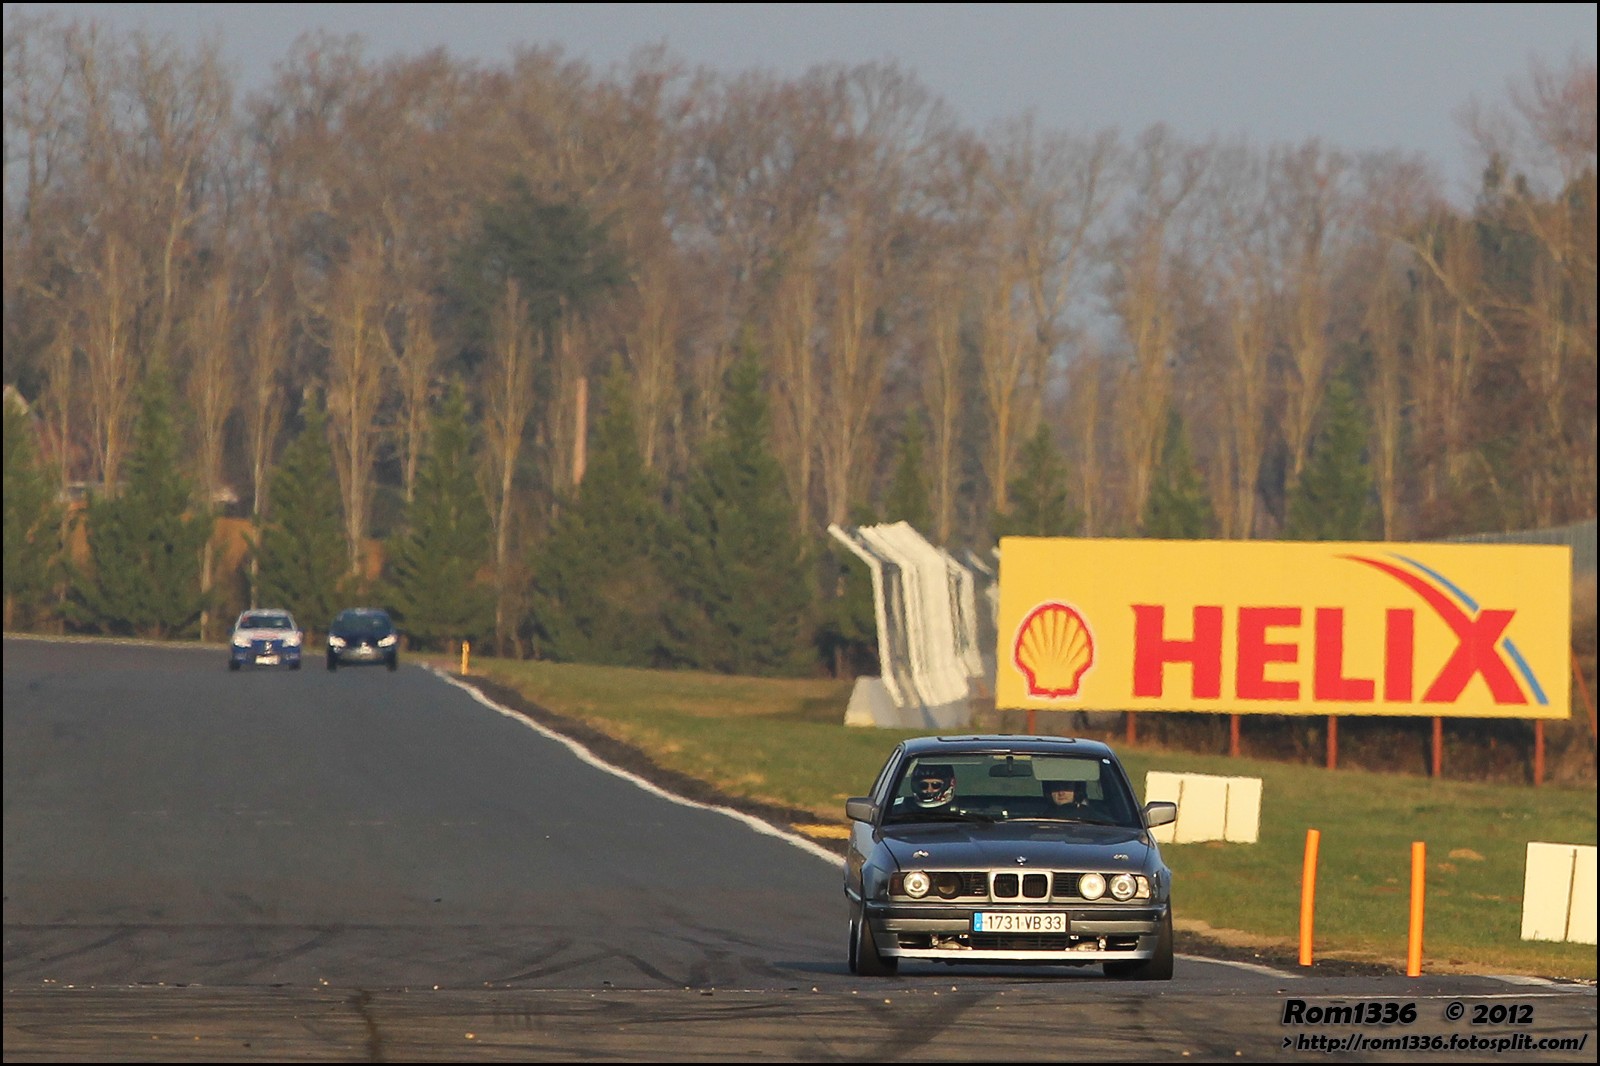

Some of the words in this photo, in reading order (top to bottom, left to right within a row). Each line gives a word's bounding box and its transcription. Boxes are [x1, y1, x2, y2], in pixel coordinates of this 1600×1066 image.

[1131, 604, 1529, 705] HELIX
[988, 915, 1020, 929] 1731
[1025, 916, 1041, 929] VB
[1045, 916, 1062, 930] 33
